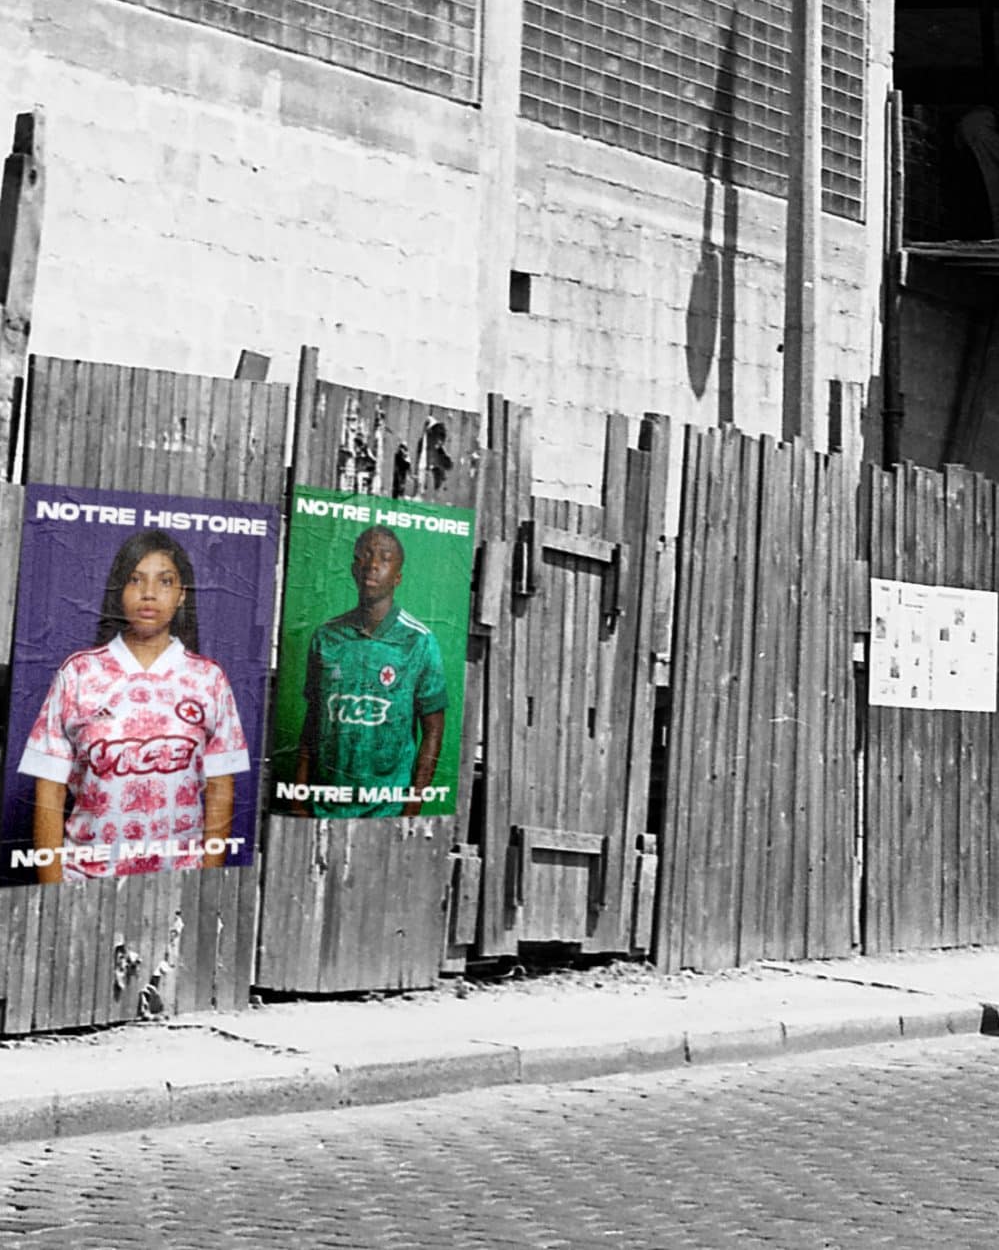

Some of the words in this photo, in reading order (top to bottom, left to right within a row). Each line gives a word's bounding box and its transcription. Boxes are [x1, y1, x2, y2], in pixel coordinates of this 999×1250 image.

[36, 500, 137, 526] NOTRE
[143, 509, 268, 537] HISTOIRE
[296, 498, 370, 520] NOTRE
[375, 508, 470, 537] HISTOIRE
[87, 735, 199, 777] VICE
[276, 782, 353, 803] NOTRE
[357, 785, 451, 804] MAILLOT
[10, 844, 112, 869] NOTRE
[119, 837, 246, 861] MAILLOT
